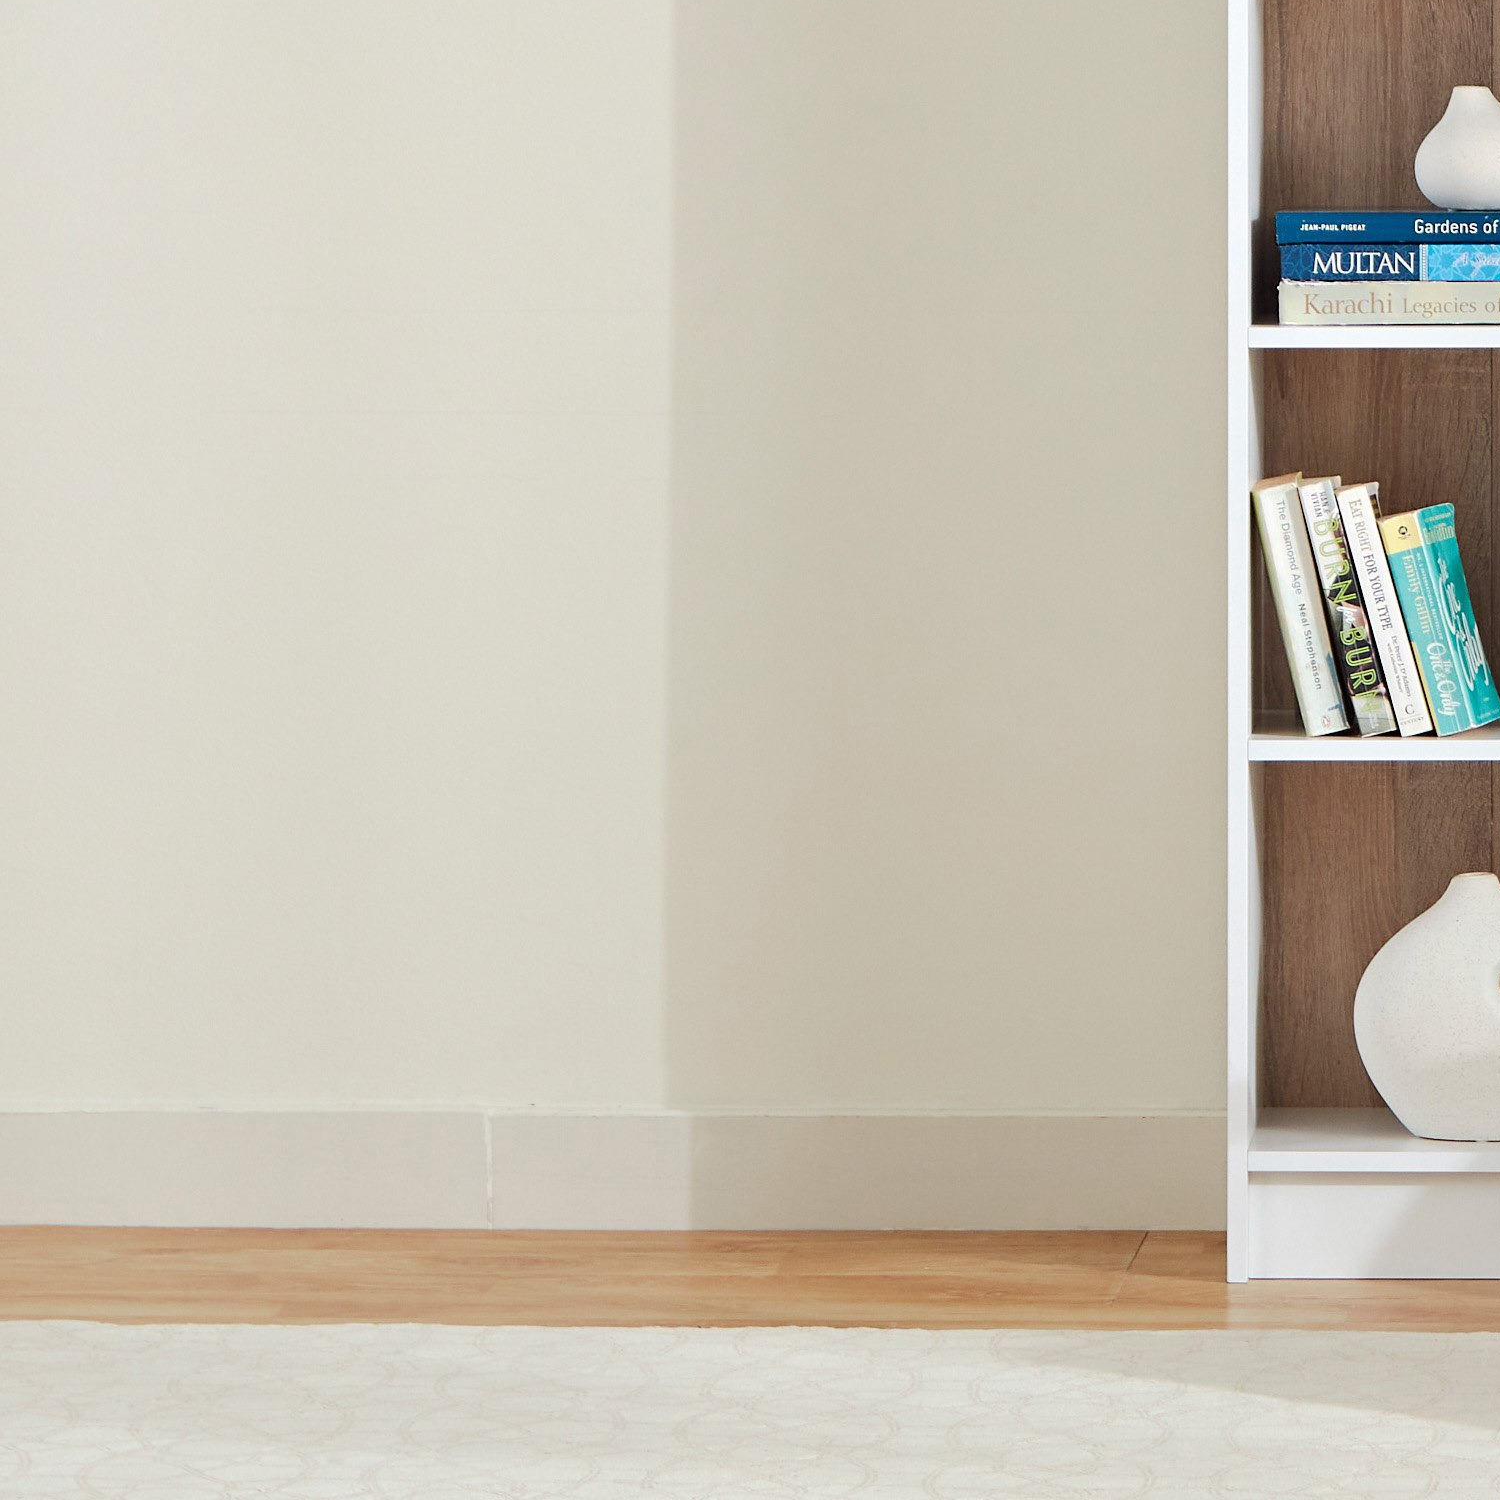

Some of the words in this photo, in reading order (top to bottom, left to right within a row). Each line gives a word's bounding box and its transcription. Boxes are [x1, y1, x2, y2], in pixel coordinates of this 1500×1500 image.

[1414, 219, 1478, 234] Gardens
[1483, 219, 1499, 234] of
[1312, 252, 1416, 274] MULTAN
[1304, 292, 1393, 315] Karachi
[1403, 298, 1477, 318] Legacies
[1311, 492, 1322, 518] VIVIAN
[1349, 499, 1362, 520] EAT
[1276, 500, 1286, 520] The
[1281, 523, 1299, 570] Diamond
[1291, 574, 1302, 595] Age
[1355, 521, 1372, 552] RIGHT
[1313, 518, 1357, 604] BURN
[1363, 554, 1378, 575] FOR
[1402, 555, 1418, 593] Emily
[1369, 575, 1386, 604] YOUR
[1378, 604, 1393, 631] TYPE
[1298, 603, 1309, 626] Neal
[1304, 629, 1322, 690] Stephenson
[1340, 628, 1382, 713] BURN
[1426, 642, 1446, 672] One
[1436, 680, 1461, 716] Only
